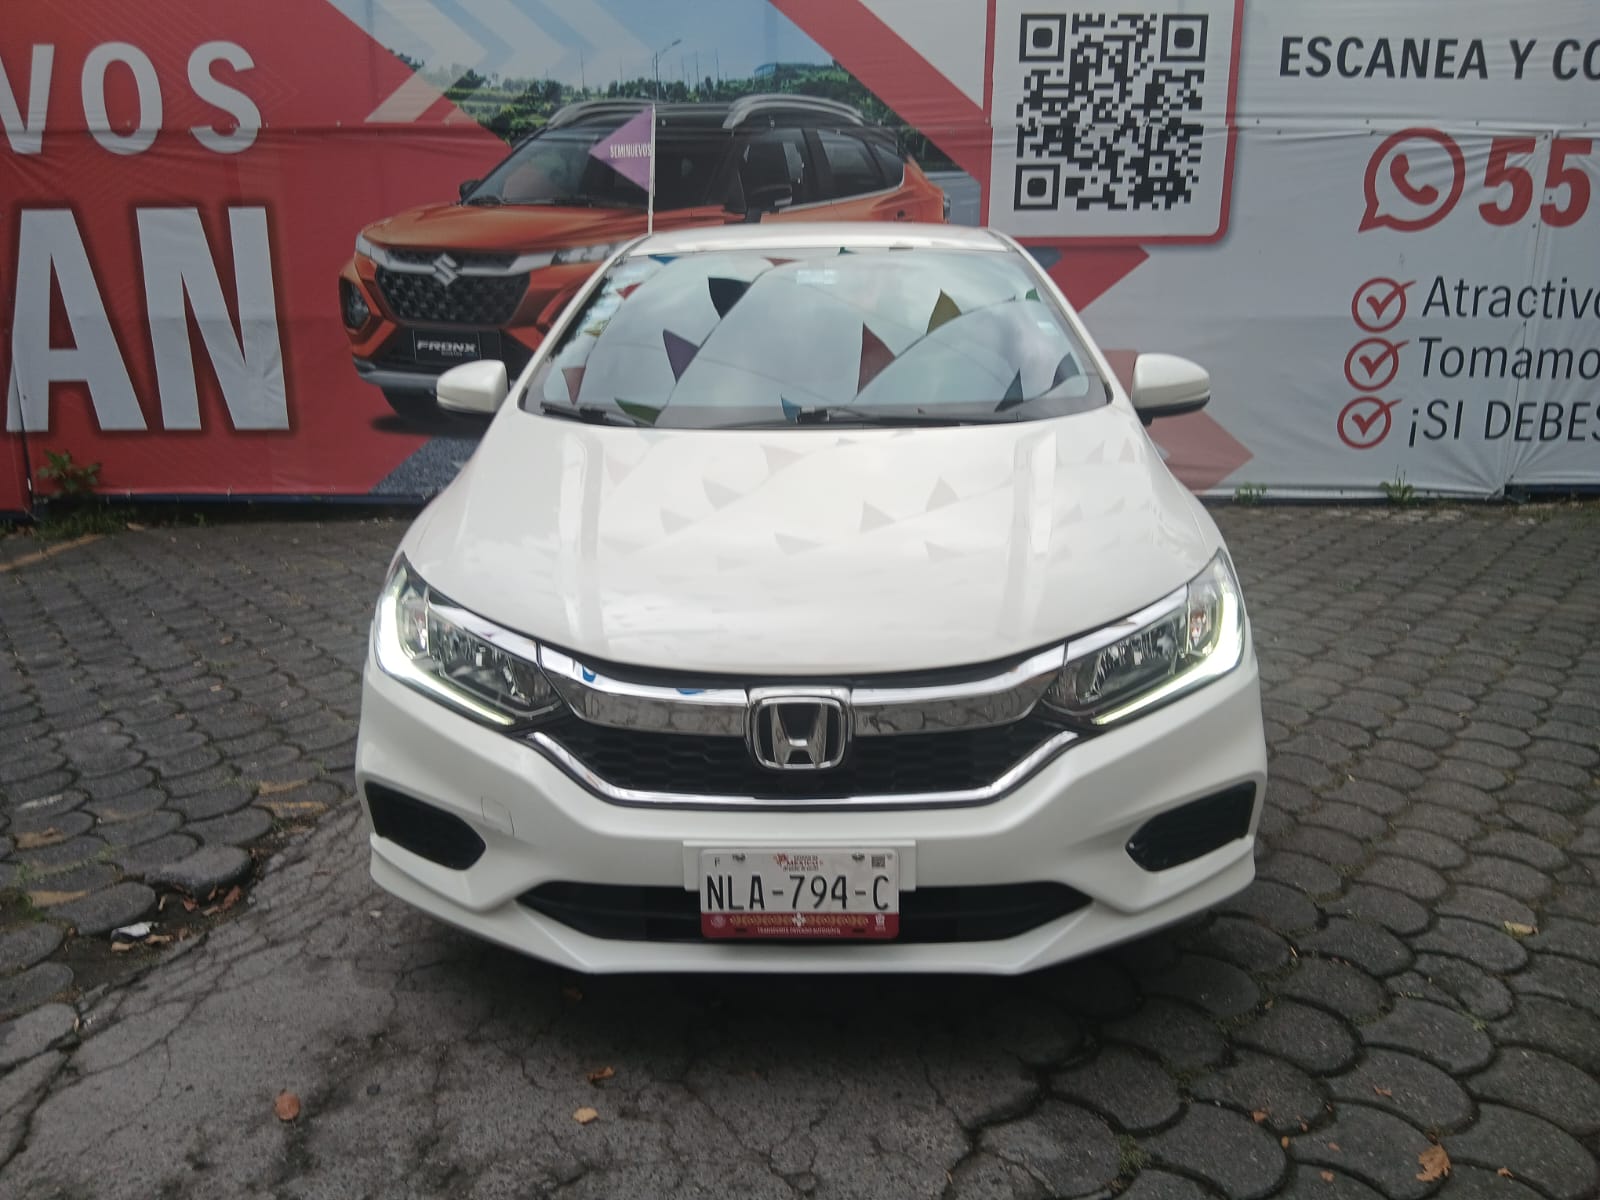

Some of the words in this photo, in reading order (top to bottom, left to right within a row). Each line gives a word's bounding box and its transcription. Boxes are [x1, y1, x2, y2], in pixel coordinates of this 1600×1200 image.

[1279, 36, 1489, 80] ESCANEA
[1509, 39, 1538, 80] Y
[0, 40, 262, 155] VOS
[1478, 136, 1593, 228] 55
[6, 206, 290, 431] AN
[417, 340, 476, 353] FRONX
[1418, 336, 1600, 380] Tomamo
[1408, 399, 1464, 448] ¡SI
[706, 875, 889, 911] NLA-794-C
